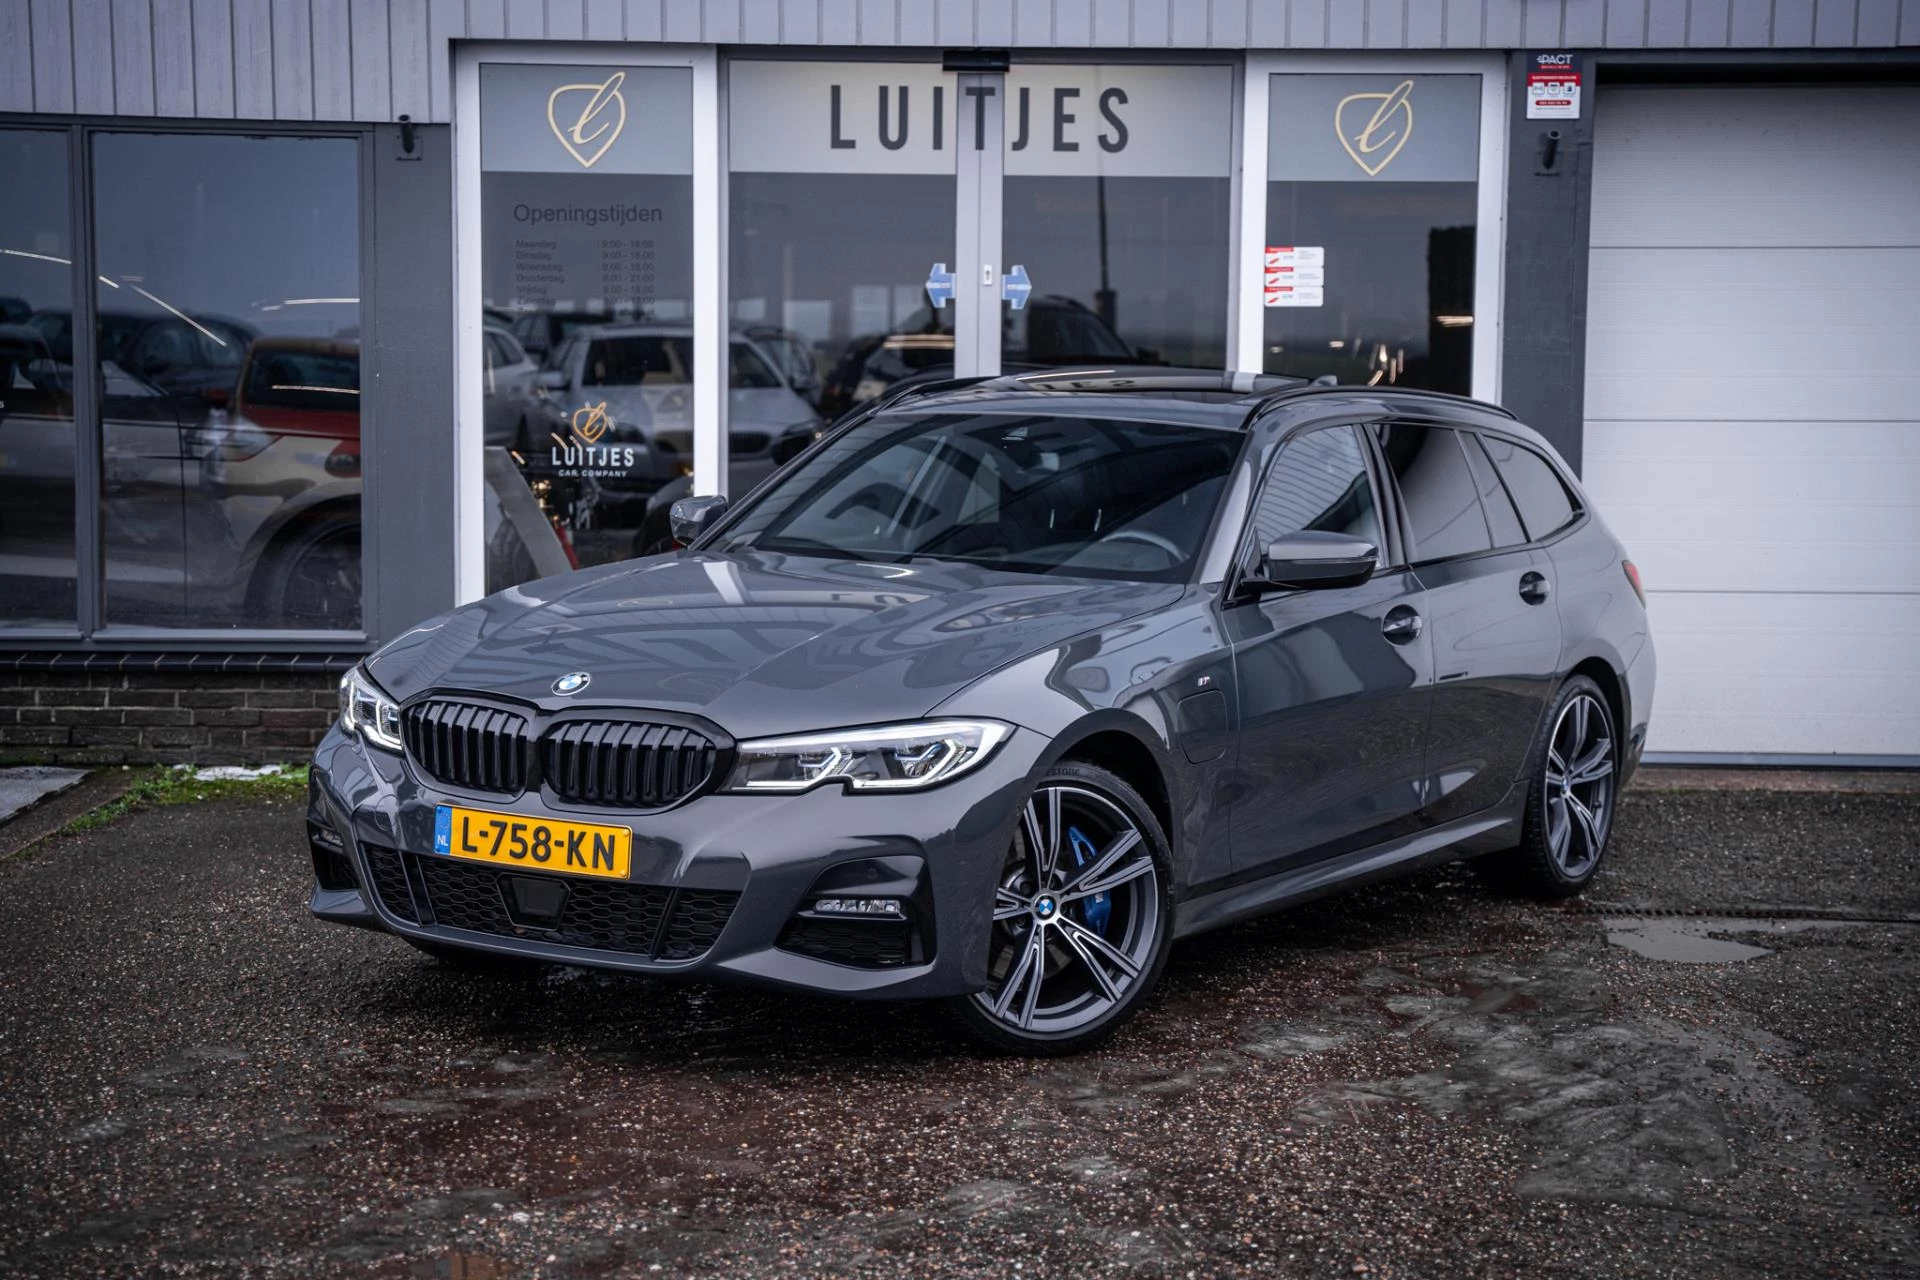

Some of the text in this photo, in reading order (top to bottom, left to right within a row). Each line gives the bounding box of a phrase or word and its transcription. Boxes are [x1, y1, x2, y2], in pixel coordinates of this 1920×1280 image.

[1541, 54, 1573, 65] PACT
[830, 85, 1129, 153] LUITJES
[513, 204, 663, 226] Openingstijden
[552, 446, 634, 467] LUITJES
[582, 469, 627, 478] COMPANY
[437, 834, 449, 846] NL
[462, 816, 616, 871] L-758-KN
